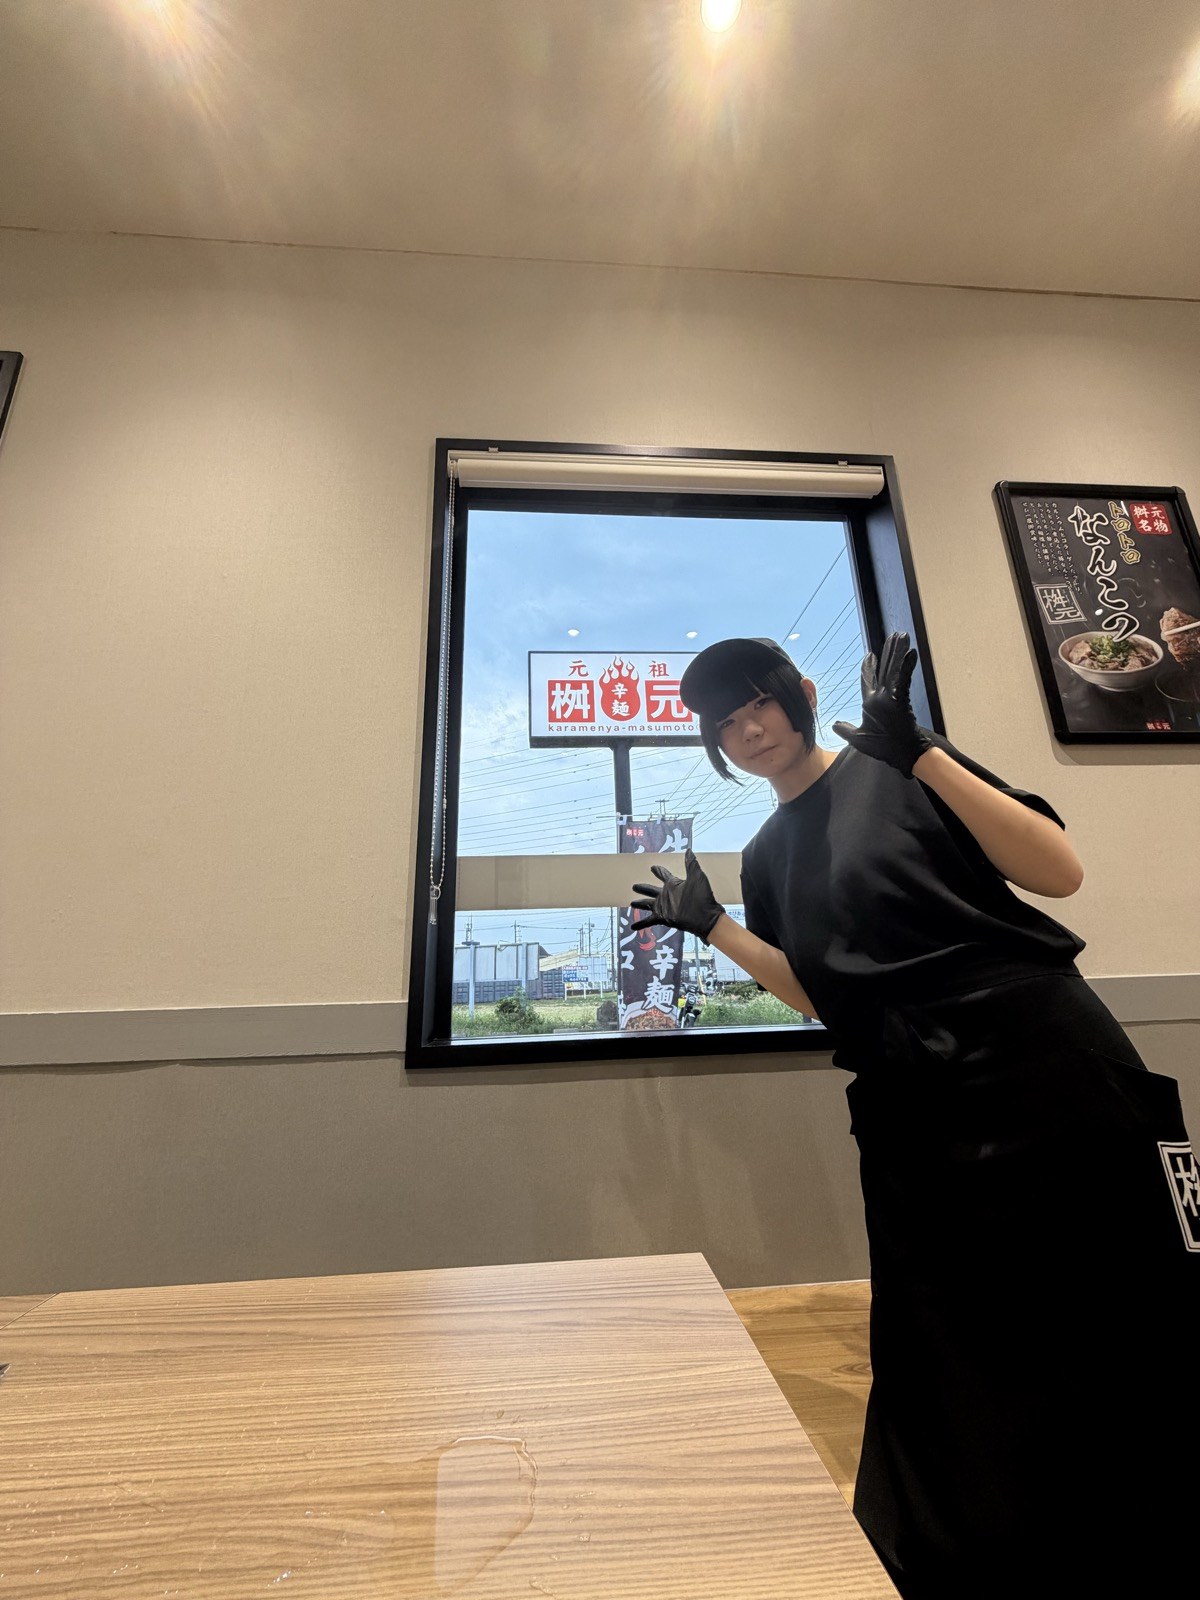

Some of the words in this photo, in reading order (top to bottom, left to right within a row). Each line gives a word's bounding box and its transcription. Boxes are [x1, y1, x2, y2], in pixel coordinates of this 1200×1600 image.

[1133, 505, 1165, 519] 桝元
[1108, 501, 1141, 565] トロトロ
[1138, 519, 1169, 533] 名物
[1067, 505, 1139, 642] なんこつ
[611, 682, 630, 717] 辛麺
[548, 723, 694, 733] karamenya-masumoto
